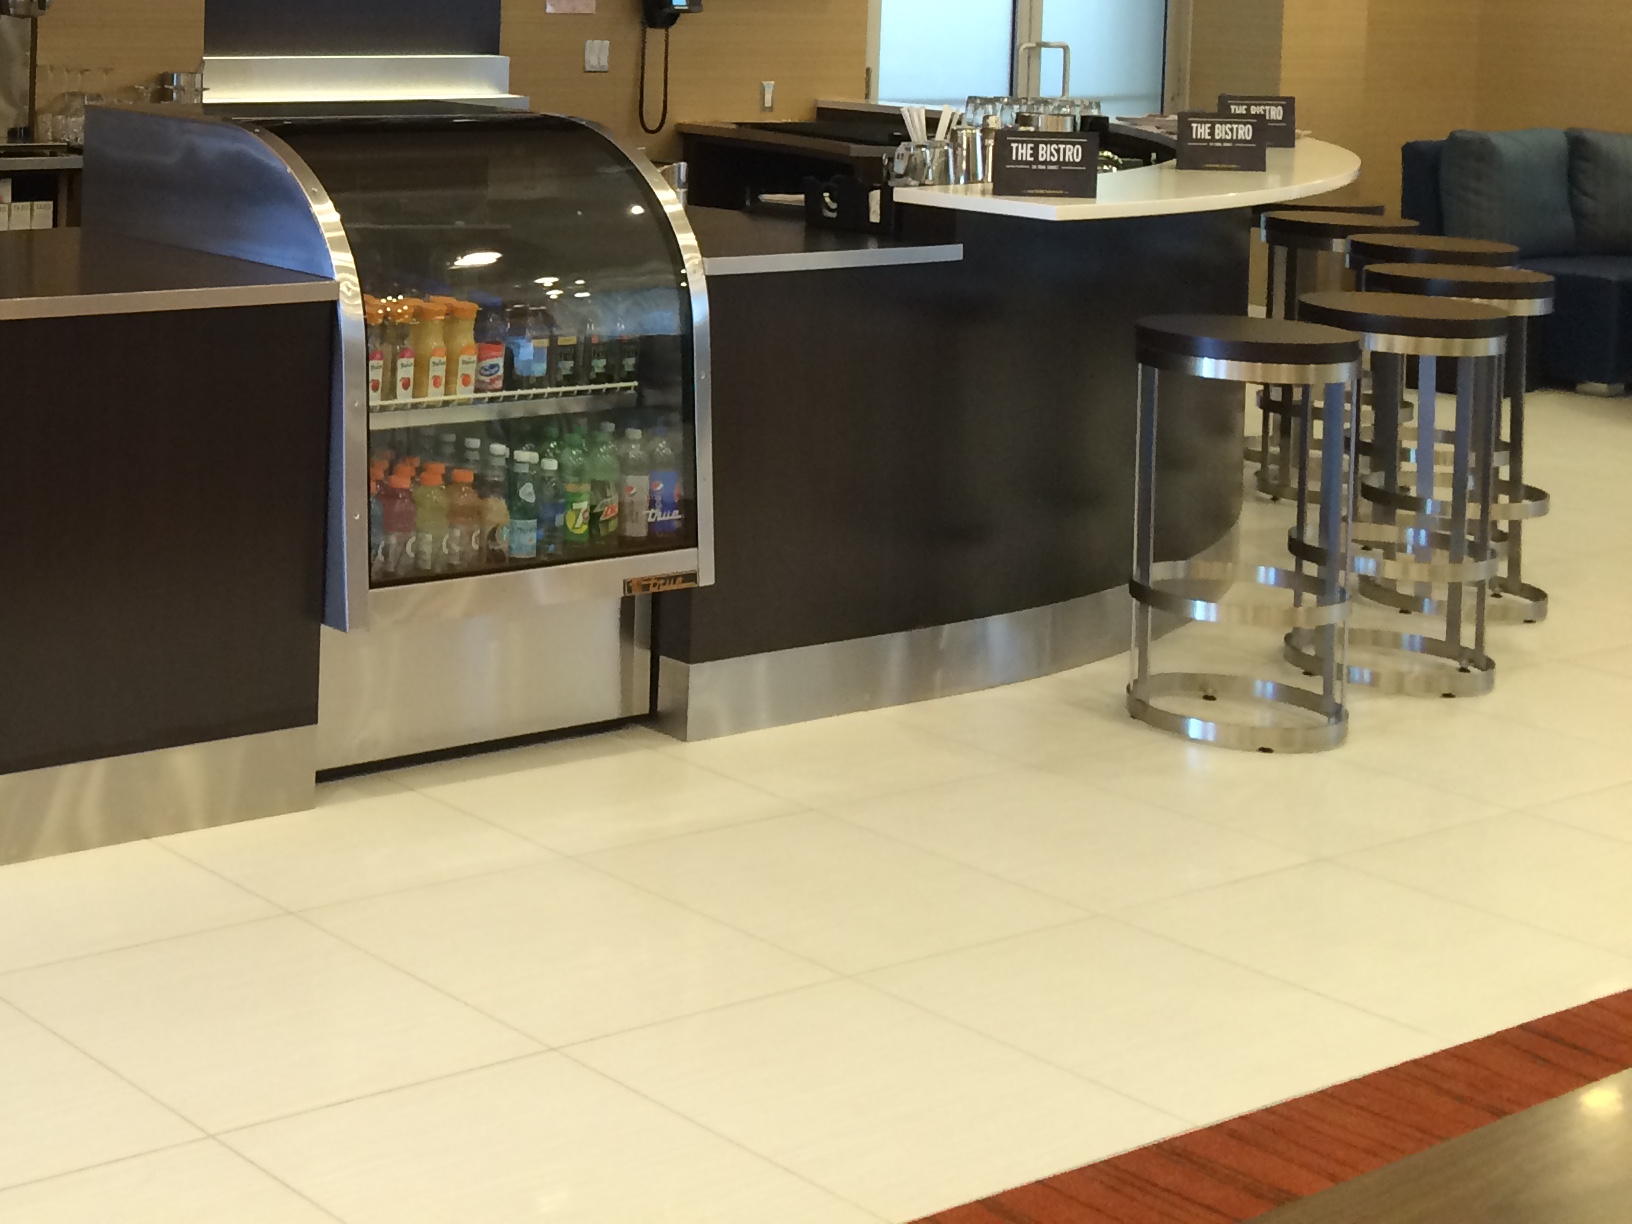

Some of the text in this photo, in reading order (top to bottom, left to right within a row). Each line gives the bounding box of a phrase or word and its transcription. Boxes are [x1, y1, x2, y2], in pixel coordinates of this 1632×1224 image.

[1191, 123, 1253, 140] THE BISTRO
[1010, 142, 1082, 163] THE BISTRO
